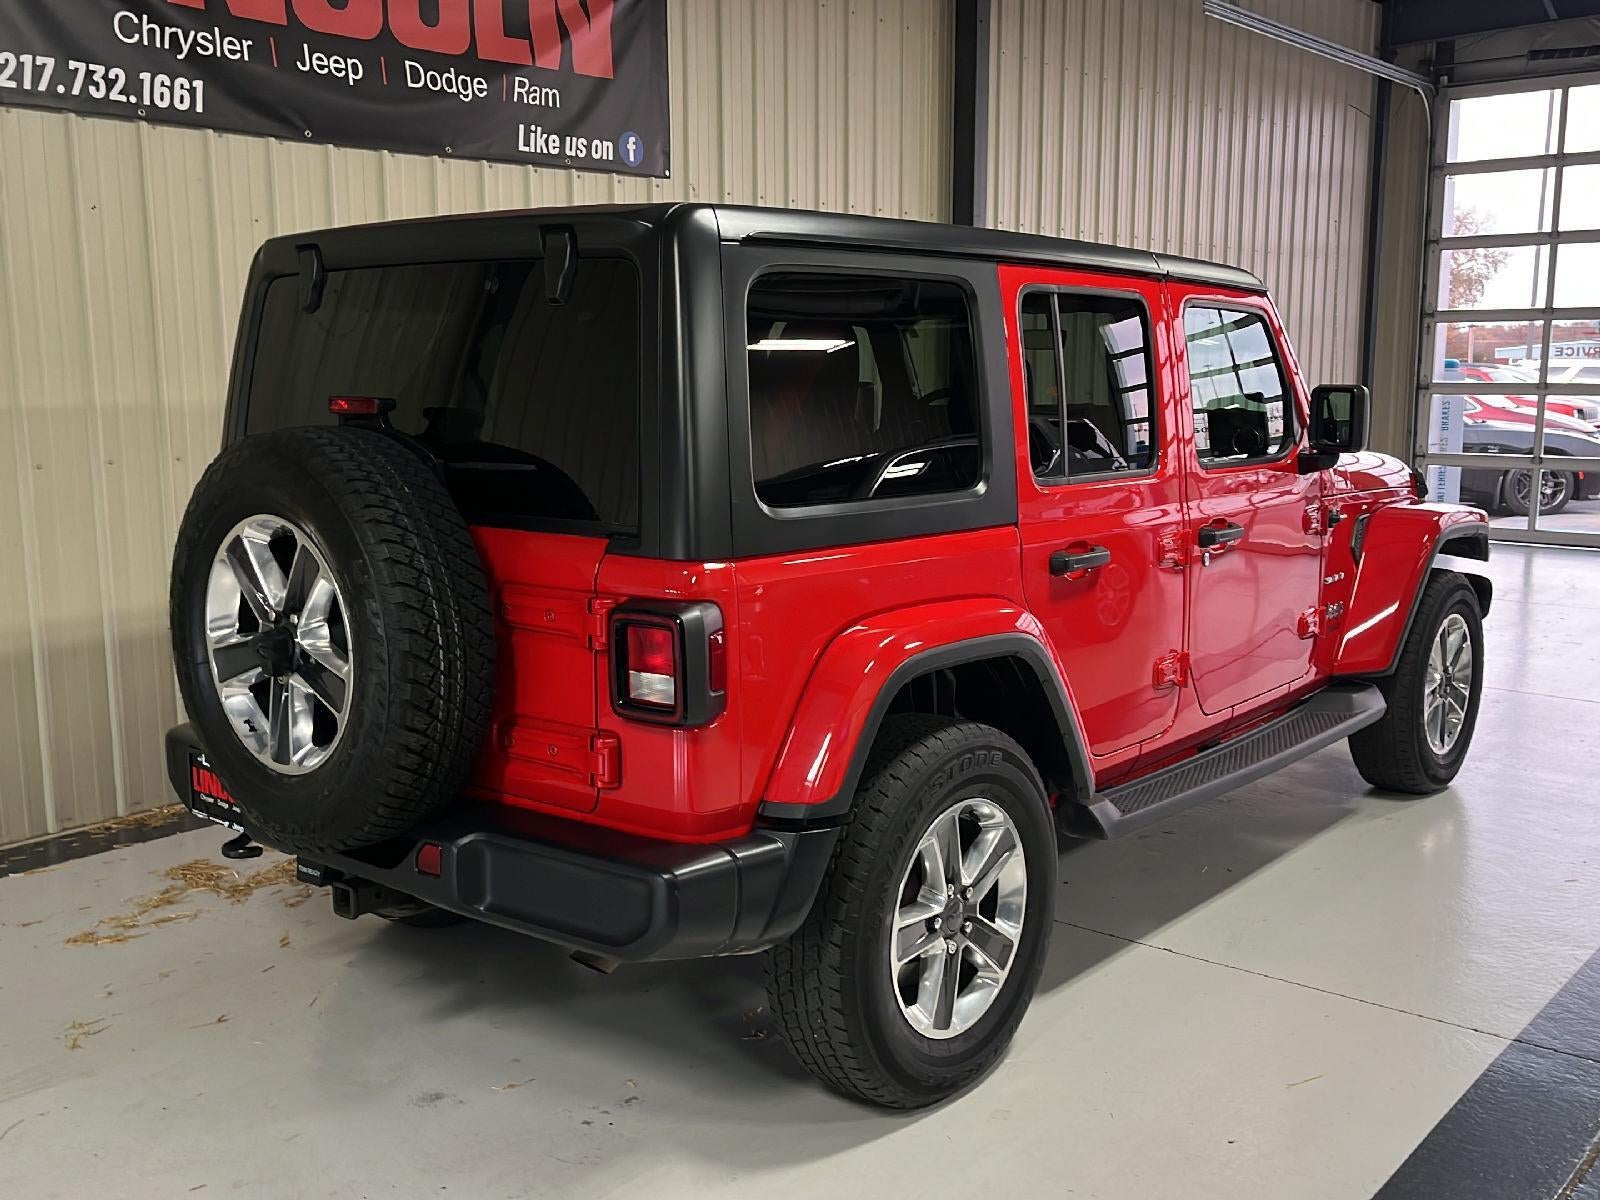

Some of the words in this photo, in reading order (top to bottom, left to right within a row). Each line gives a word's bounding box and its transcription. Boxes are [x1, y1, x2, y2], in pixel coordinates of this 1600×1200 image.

[0, 52, 204, 113] 217.732.1661
[113, 10, 252, 61] Chrysler
[297, 43, 363, 85] Jeep
[404, 60, 488, 102] Dodge
[513, 76, 560, 108] Ram
[518, 123, 560, 155] Like
[565, 135, 587, 158] us
[591, 138, 614, 160] on
